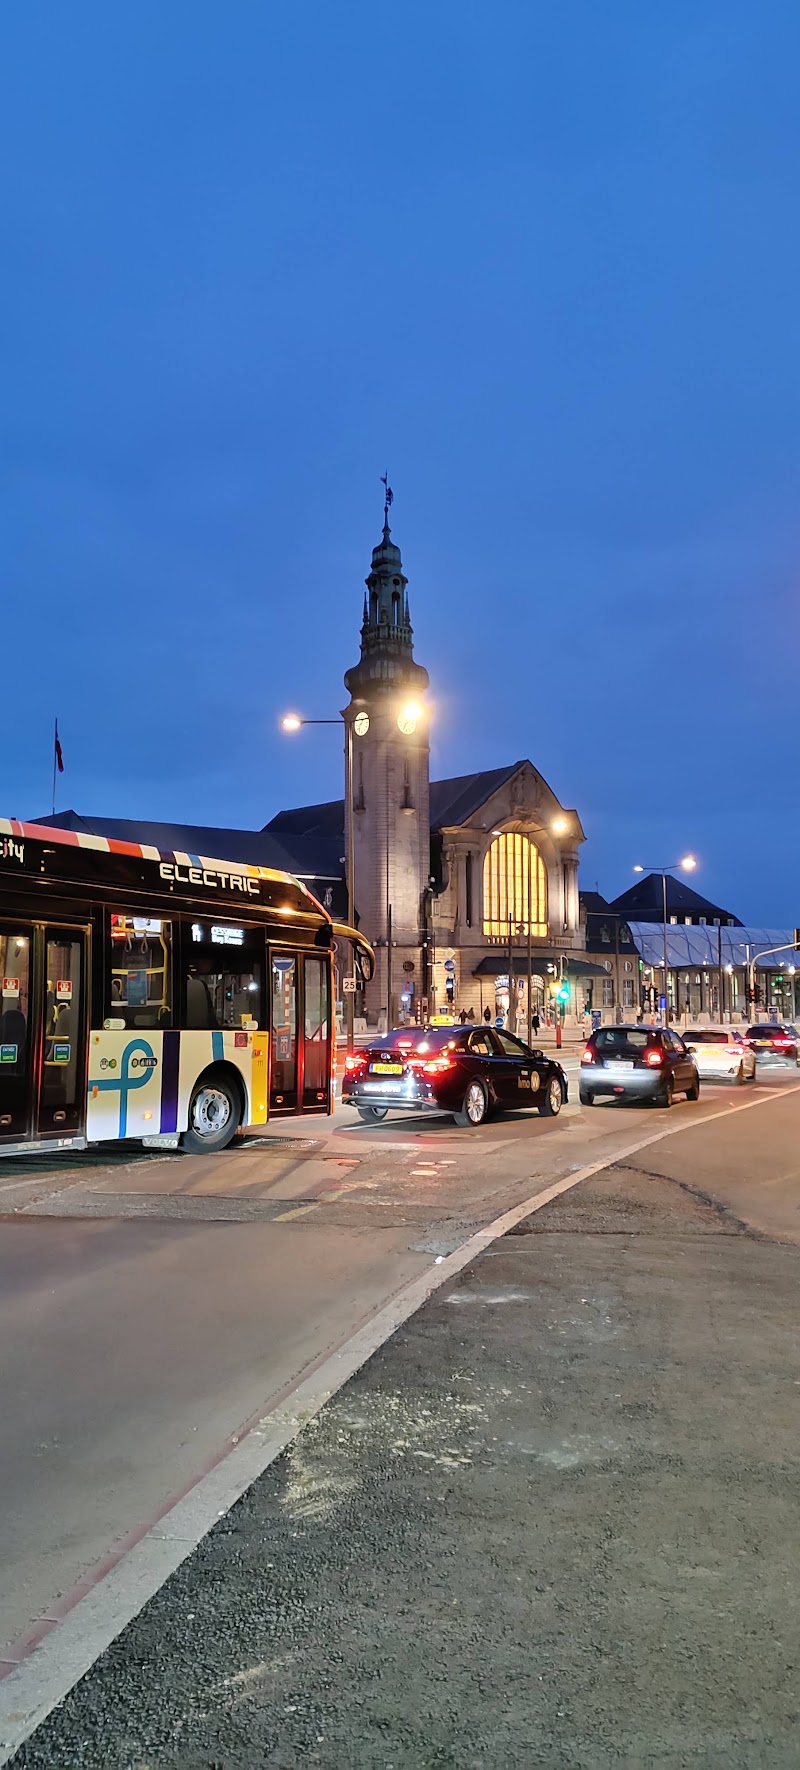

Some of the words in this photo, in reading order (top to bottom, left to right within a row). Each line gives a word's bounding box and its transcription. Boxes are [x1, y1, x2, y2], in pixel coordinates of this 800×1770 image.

[159, 862, 261, 895] ELECTRIC
[344, 981, 355, 990] 25
[142, 1137, 178, 1147] VOLVO
